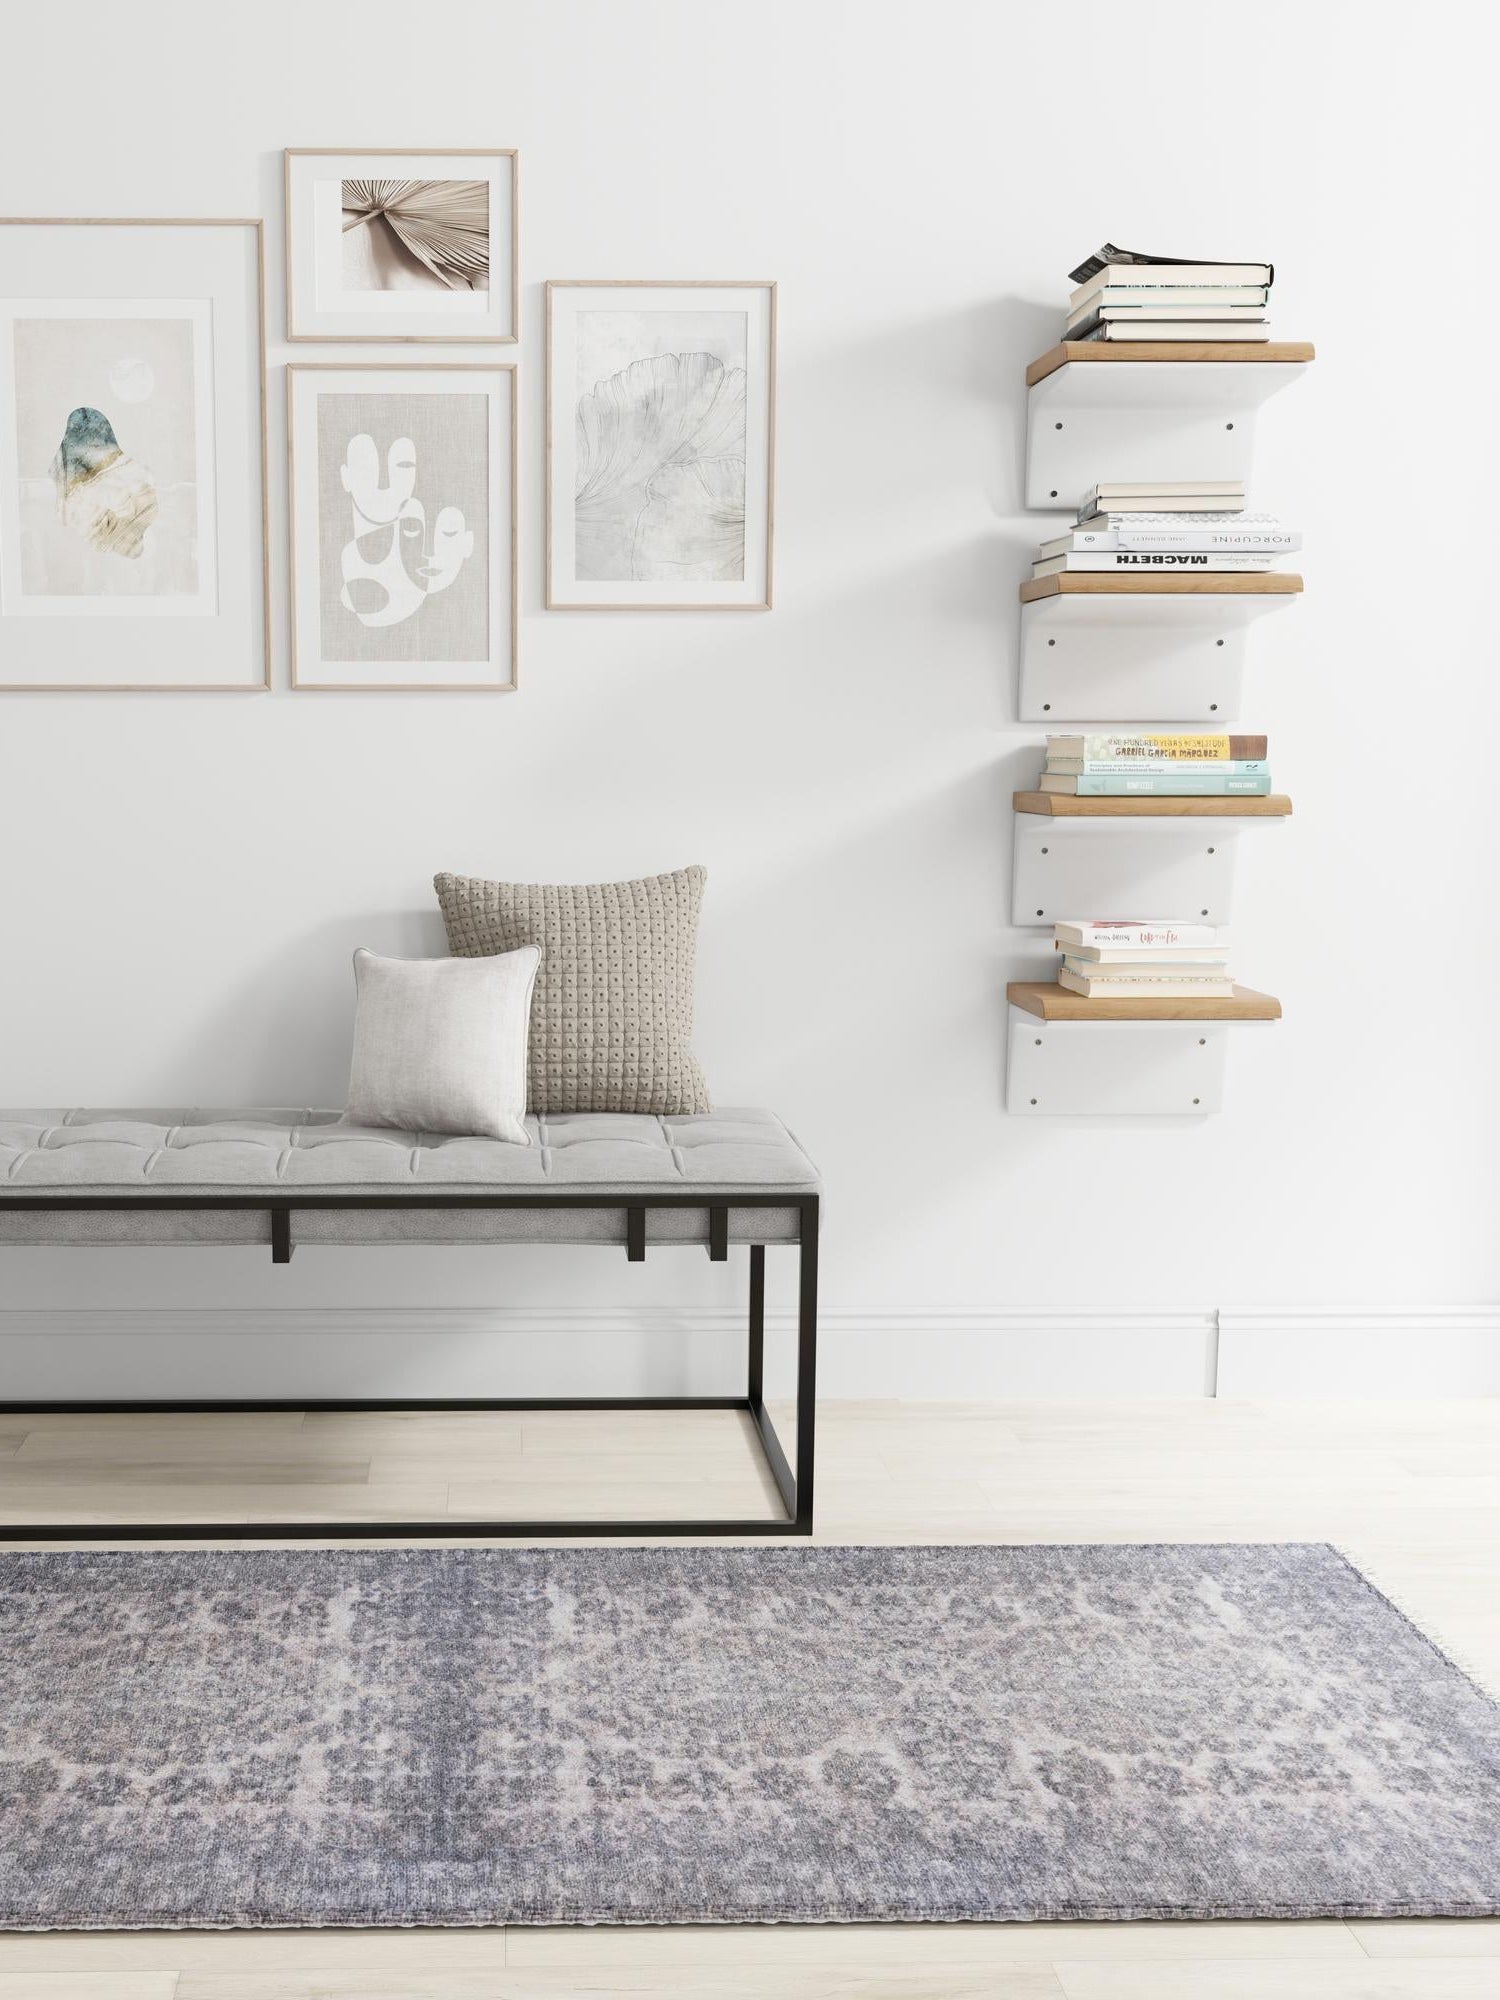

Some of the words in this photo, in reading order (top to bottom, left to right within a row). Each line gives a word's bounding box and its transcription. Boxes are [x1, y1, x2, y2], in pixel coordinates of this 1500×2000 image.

[1211, 535, 1291, 544] PORCUPINE
[1116, 555, 1208, 564] MACBETH
[1115, 747, 1146, 756] GABRIEL
